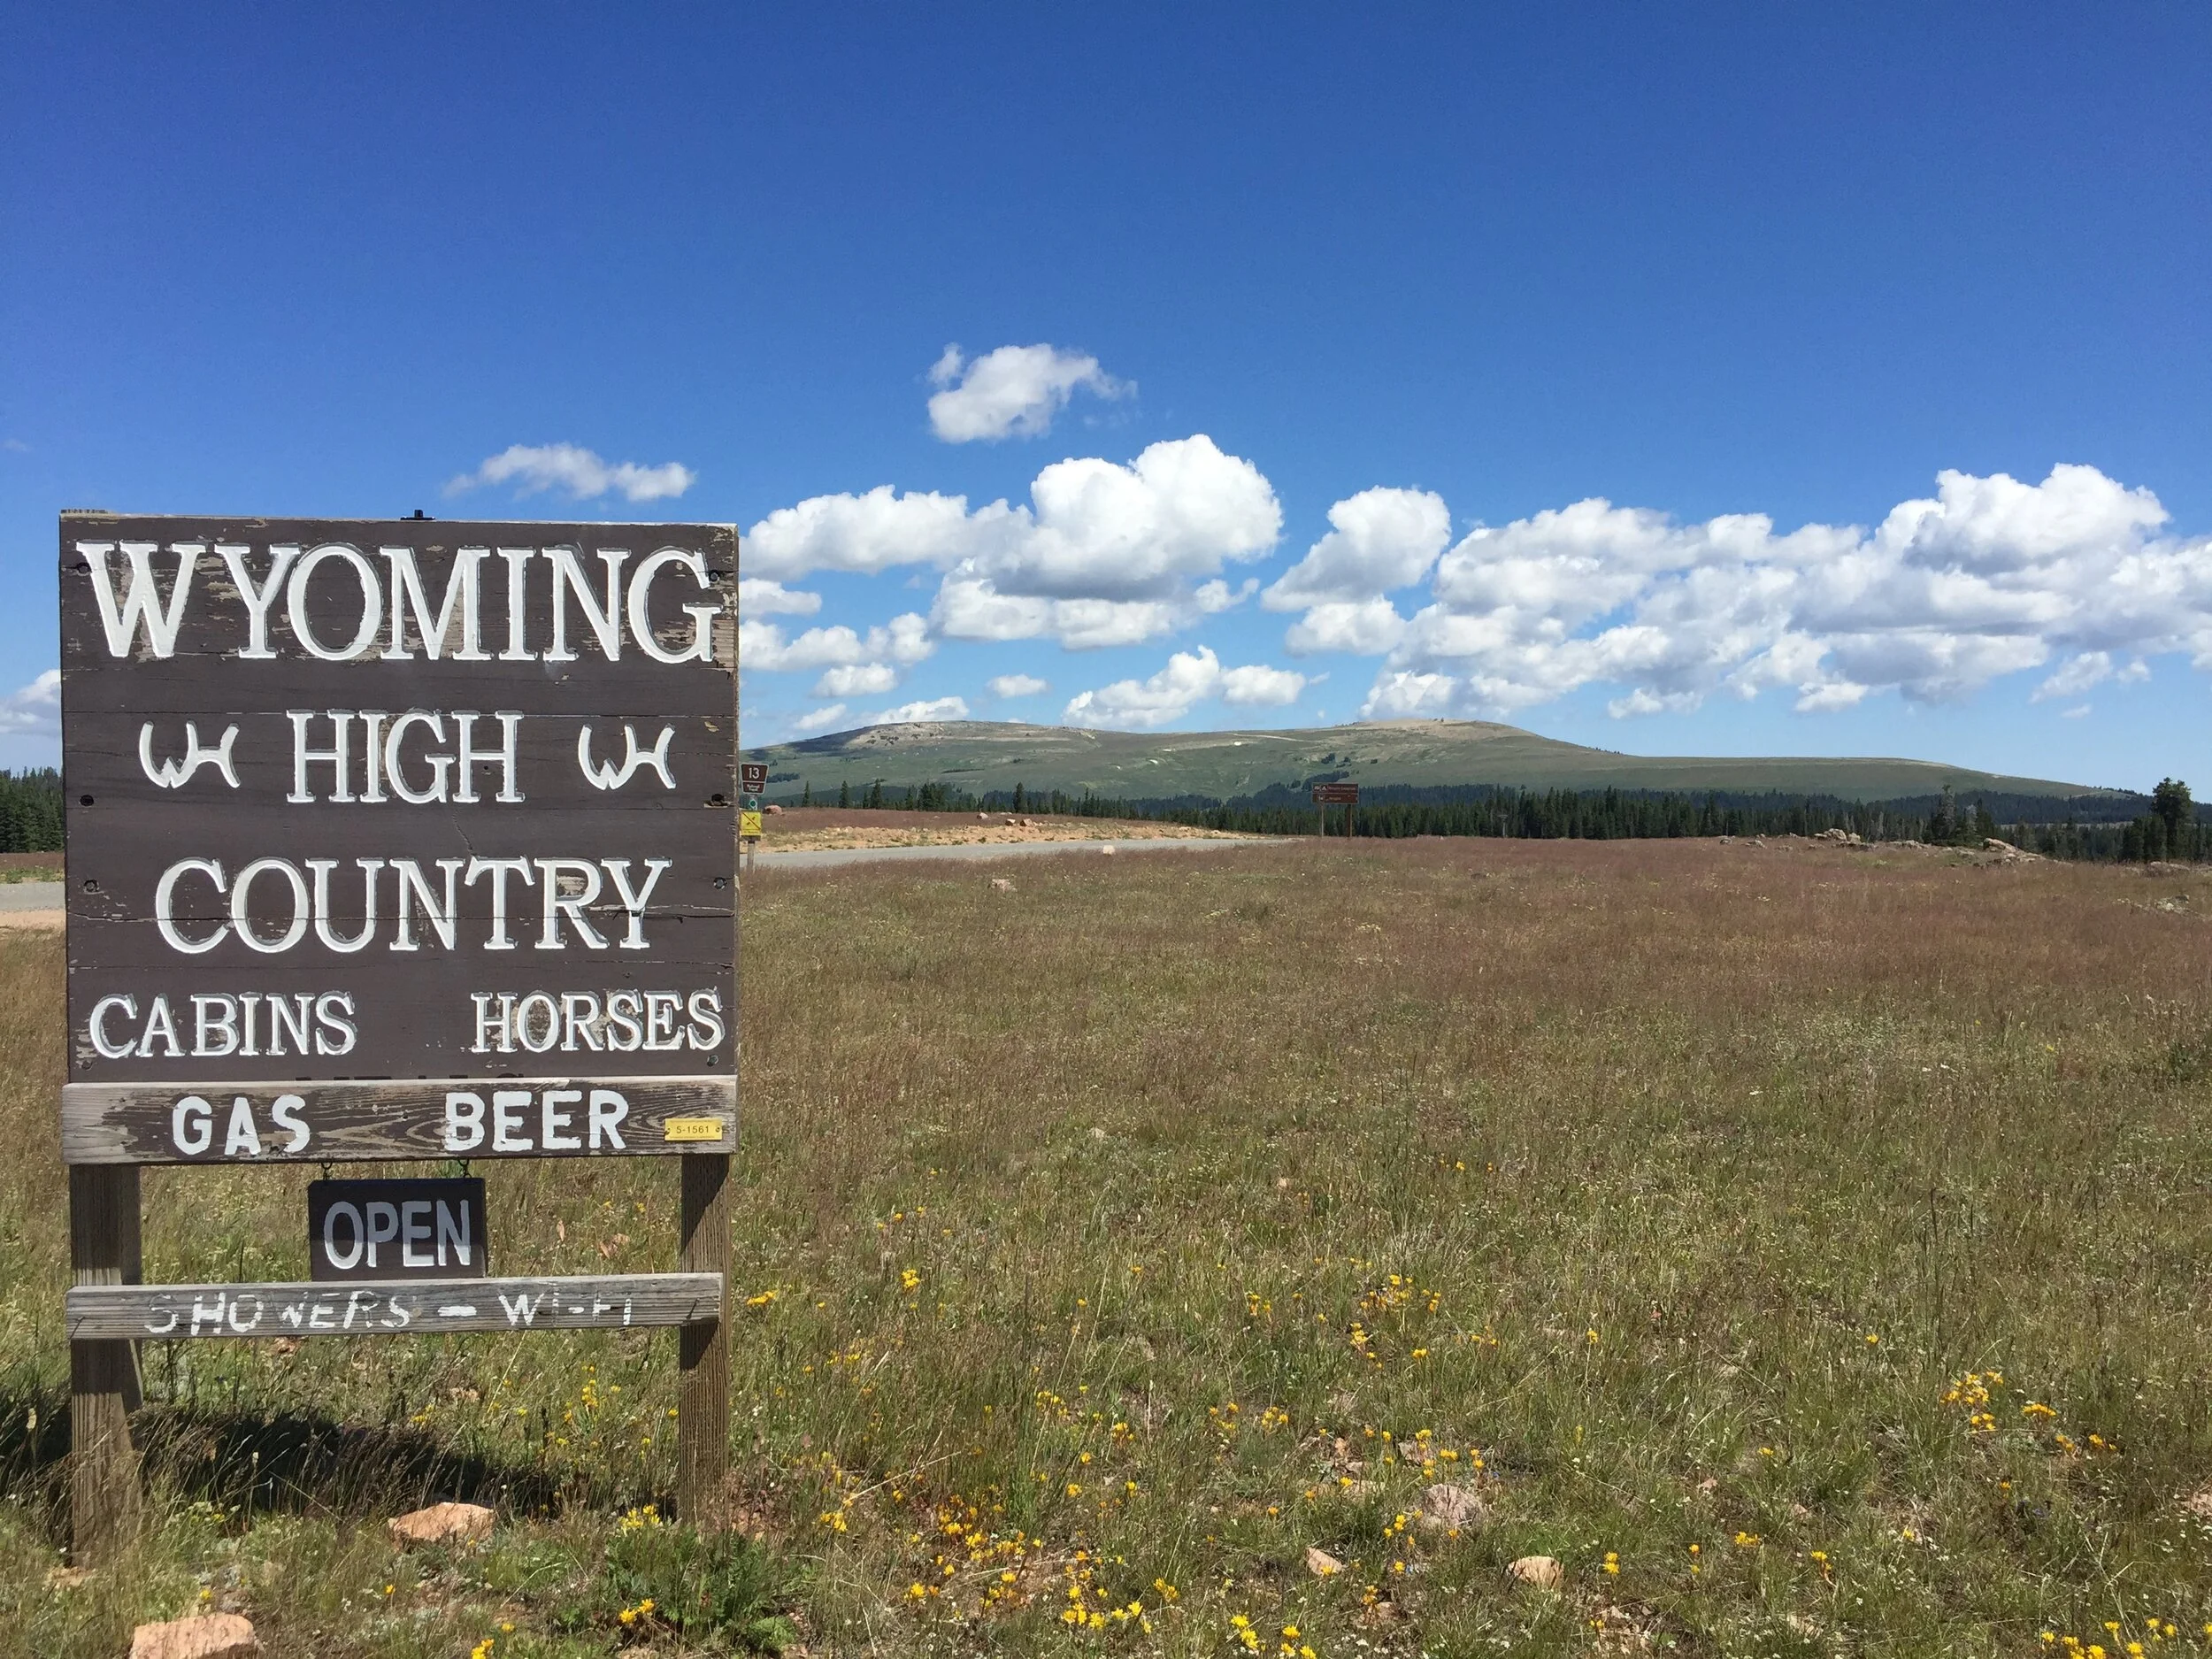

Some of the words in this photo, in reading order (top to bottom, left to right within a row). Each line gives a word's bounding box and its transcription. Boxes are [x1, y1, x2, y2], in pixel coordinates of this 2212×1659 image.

[75, 539, 722, 664] WYOMING
[286, 708, 526, 804] HIGH
[749, 767, 760, 779] 13
[155, 856, 673, 955] COUNTRY
[88, 992, 357, 1059] CABINS
[469, 987, 726, 1055] HORSES
[172, 1094, 311, 1156] GAS
[444, 1089, 630, 1153] BEER
[675, 1125, 710, 1134] 5-1561
[322, 1200, 472, 1271] OPEN
[144, 1291, 411, 1336] SHOWERS
